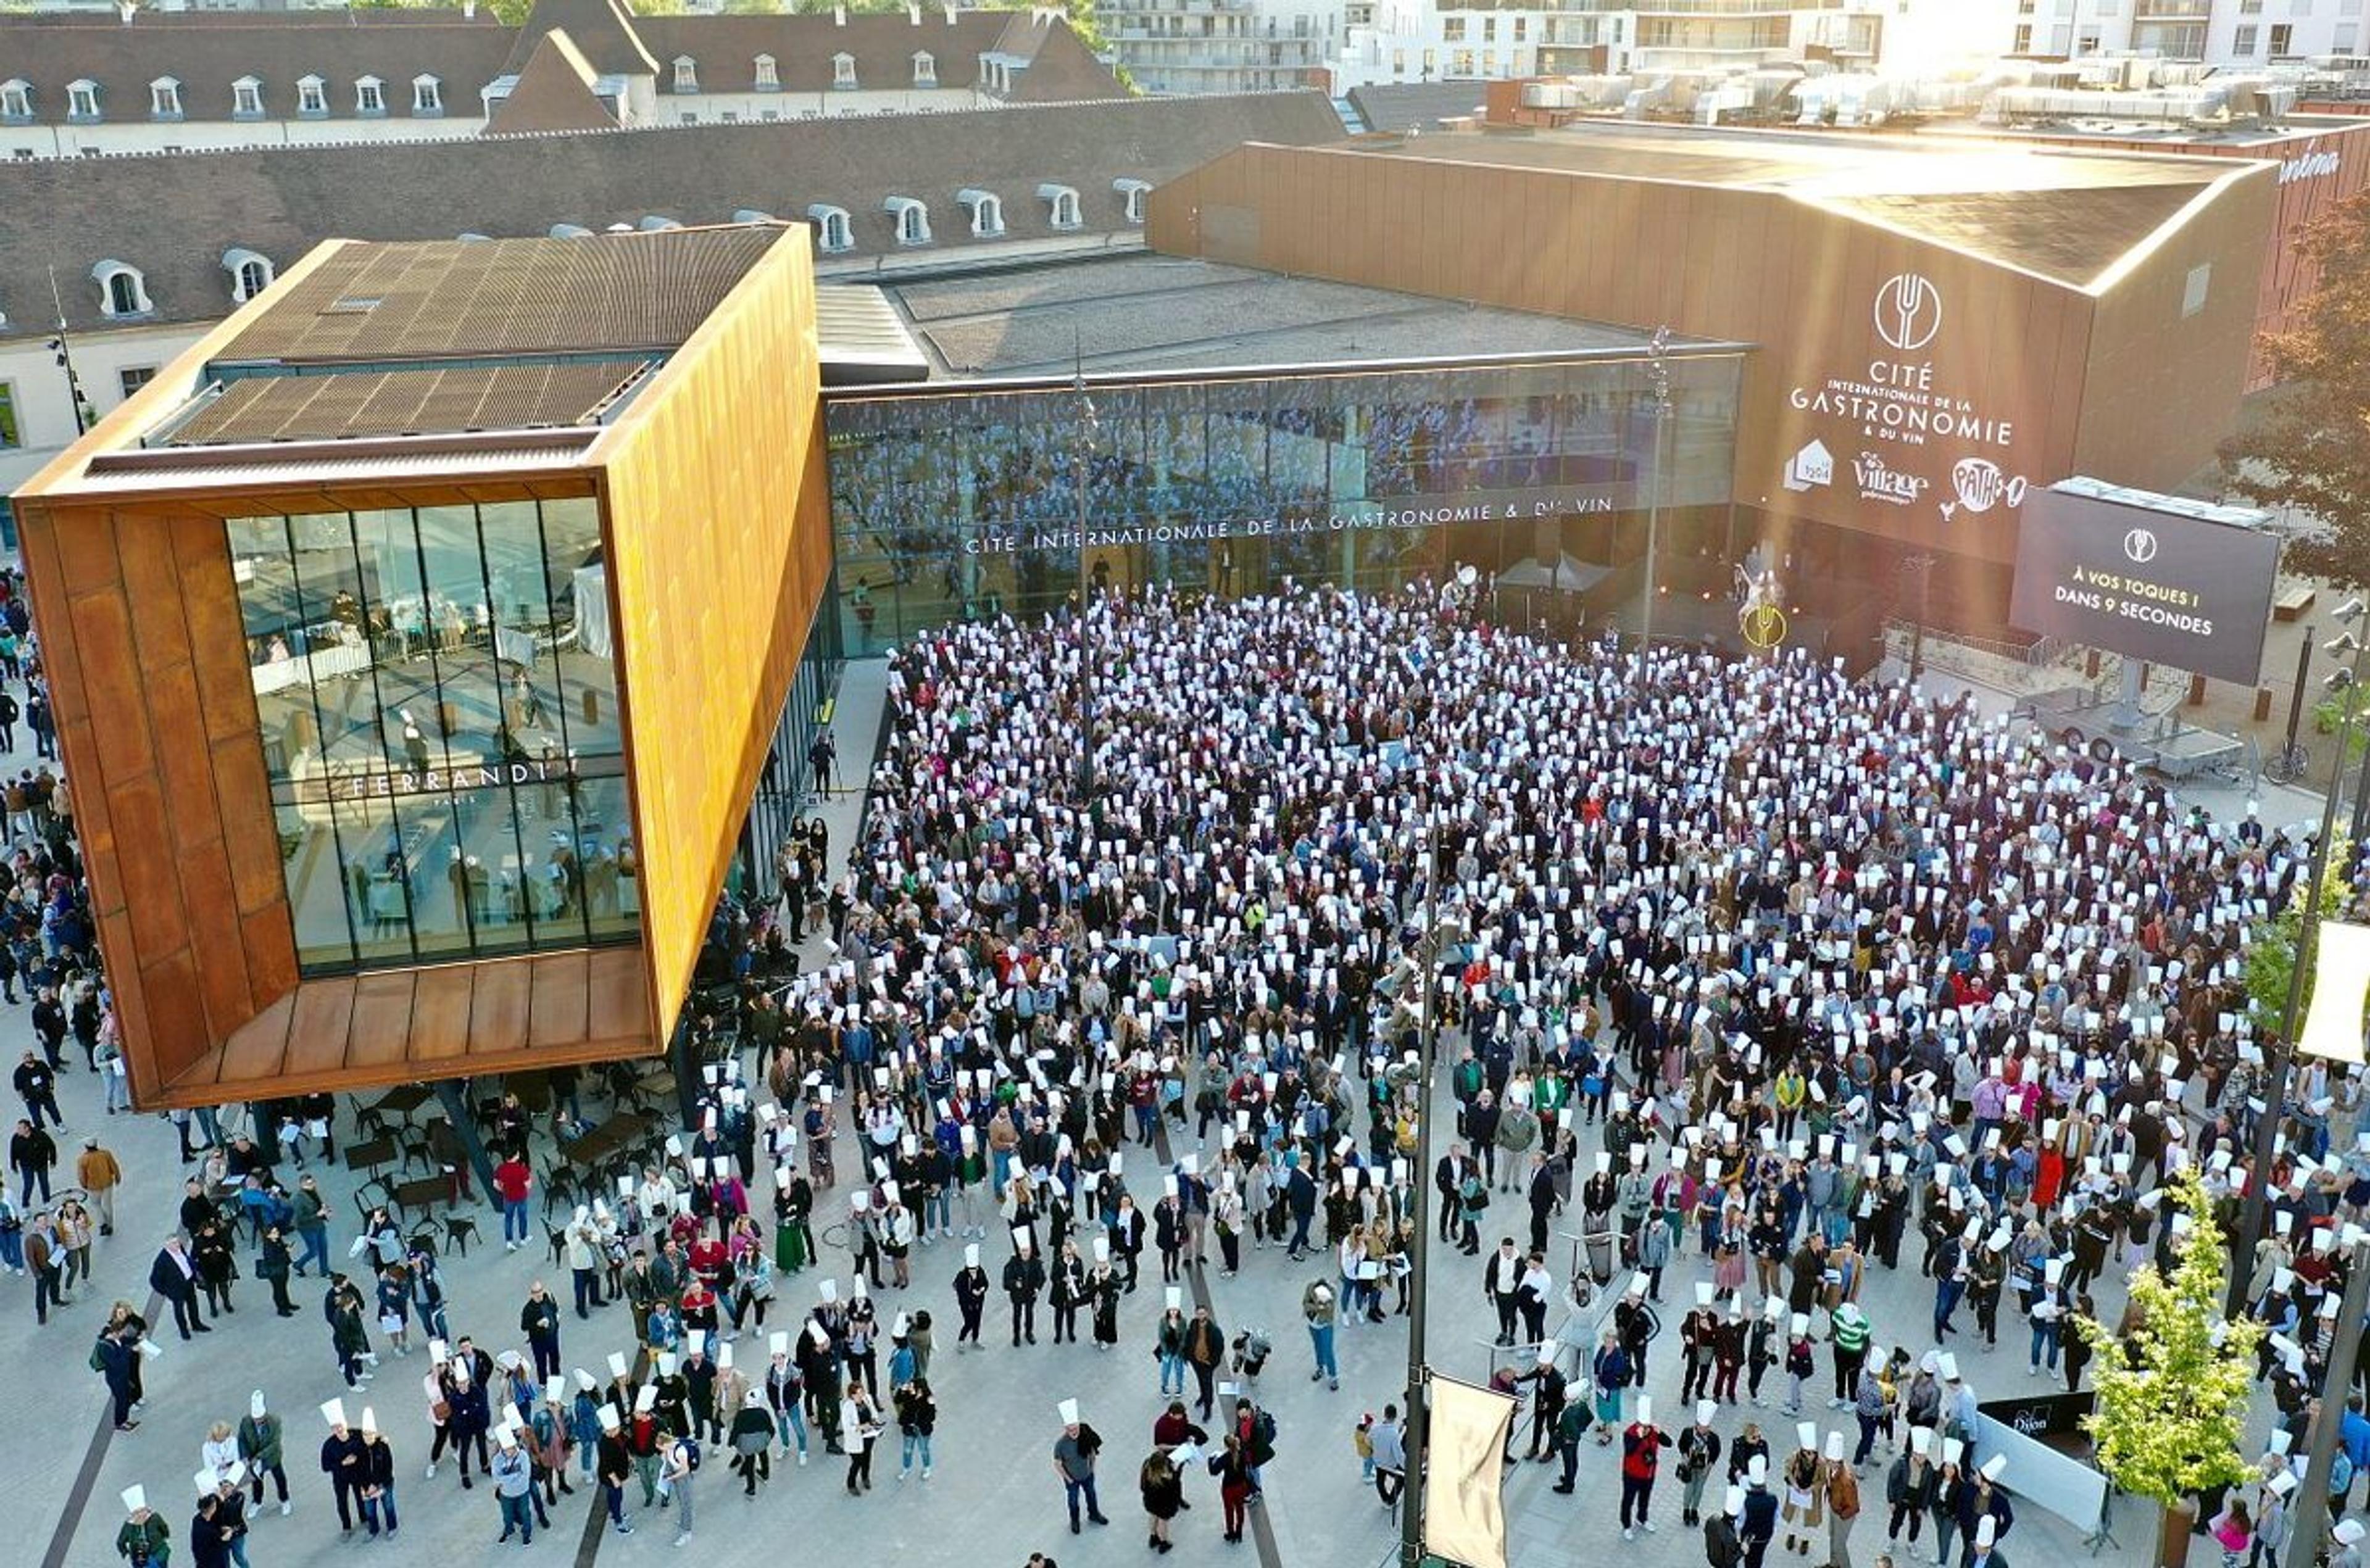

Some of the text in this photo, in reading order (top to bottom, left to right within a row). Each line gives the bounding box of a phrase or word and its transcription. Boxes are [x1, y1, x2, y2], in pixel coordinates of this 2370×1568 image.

[2279, 137, 2340, 185] inéma
[1869, 360, 1933, 390] CITÉ
[1827, 380, 1971, 412] INTERNATIONALE DE LA
[1790, 388, 2012, 445] GASTRONOMIE
[1879, 428, 1896, 440] DU
[1903, 432, 1924, 444] VIN
[1850, 458, 1929, 498] Village
[1033, 522, 1228, 550] INTERNATIONALE
[1248, 520, 1273, 536] DE
[1291, 519, 1313, 533] LA
[1329, 507, 1490, 530] GASTRONOMIE
[1505, 504, 1516, 517] &
[1576, 497, 1611, 513] VIN
[2089, 571, 2120, 590] VOS
[2125, 578, 2188, 605] TOQUES
[2055, 586, 2213, 636] DANS 9 SECONDES
[352, 763, 546, 795] FERRANDI
[2013, 1417, 2047, 1434] Dijon
